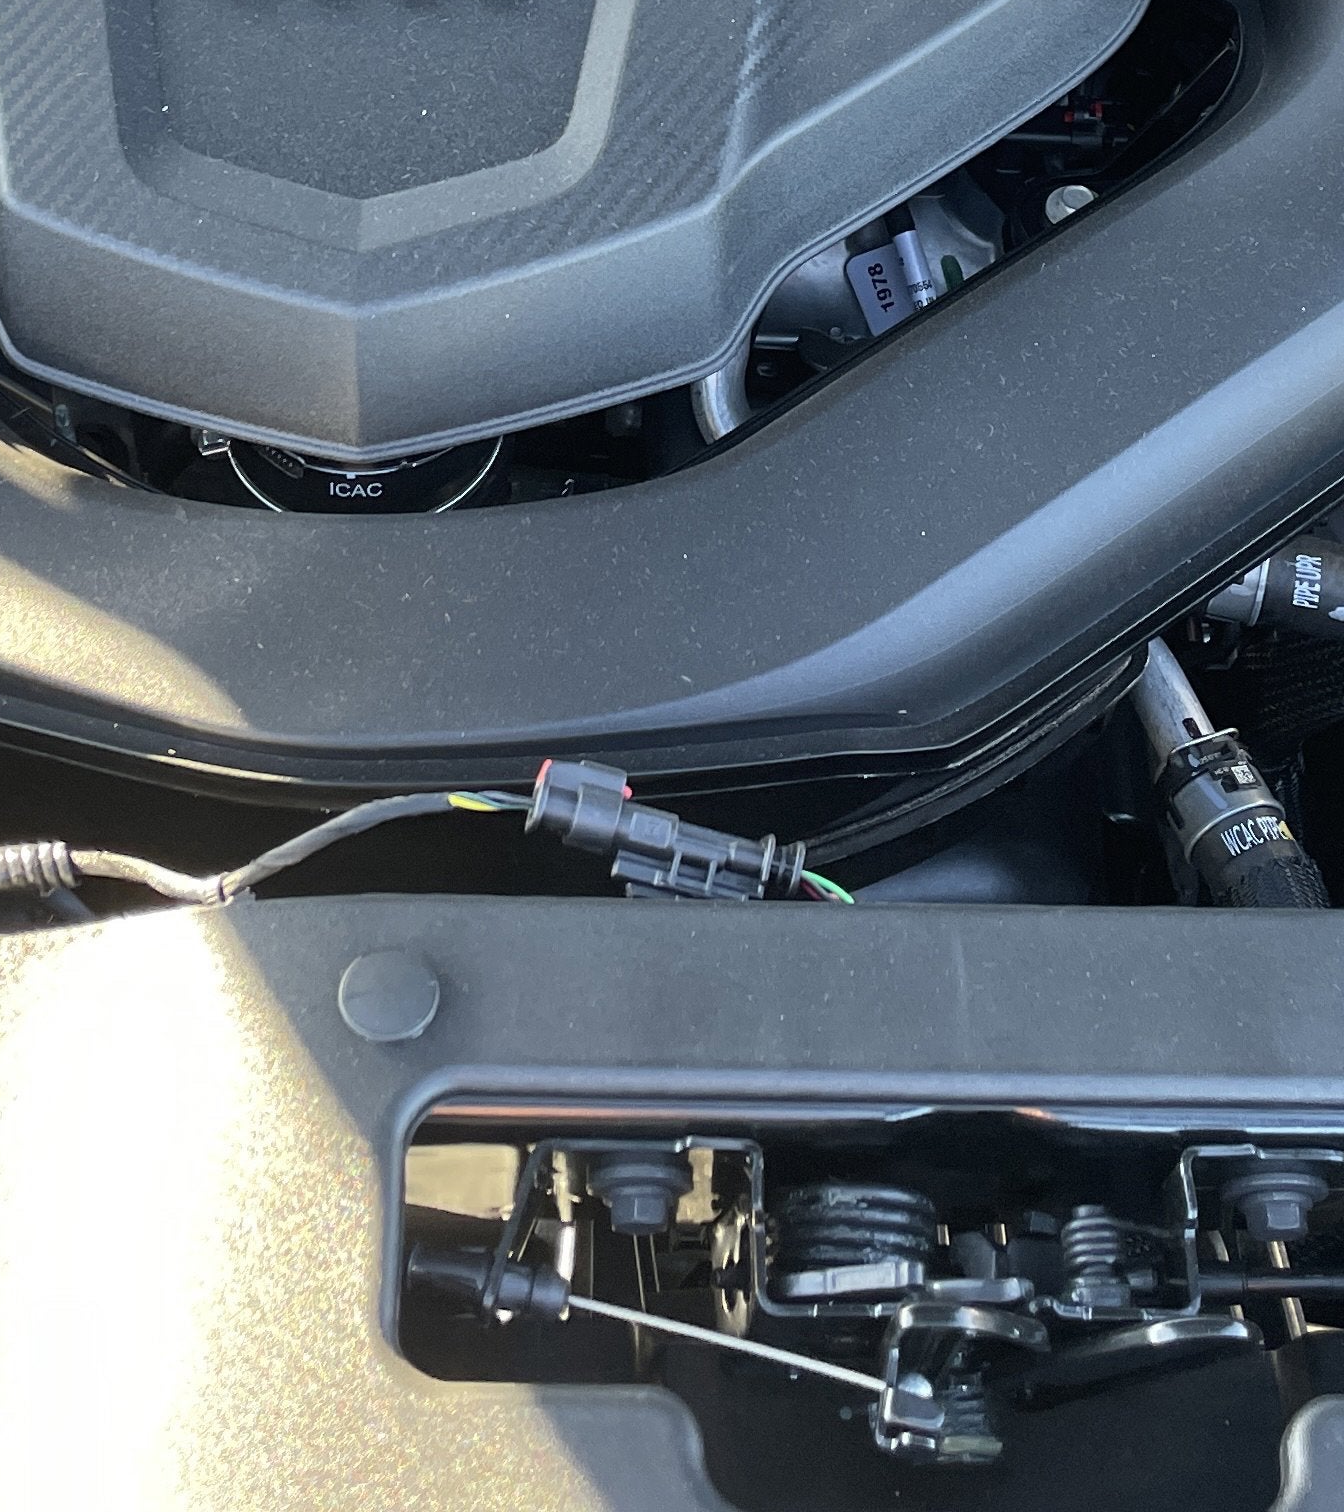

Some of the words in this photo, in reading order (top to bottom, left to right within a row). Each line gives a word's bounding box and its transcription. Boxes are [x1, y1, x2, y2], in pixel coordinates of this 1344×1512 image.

[867, 263, 895, 313] 1978
[328, 481, 384, 499] ICAC
[1295, 554, 1322, 581] UPR
[1292, 580, 1321, 609] PIPE
[1220, 818, 1264, 857] WCAC
